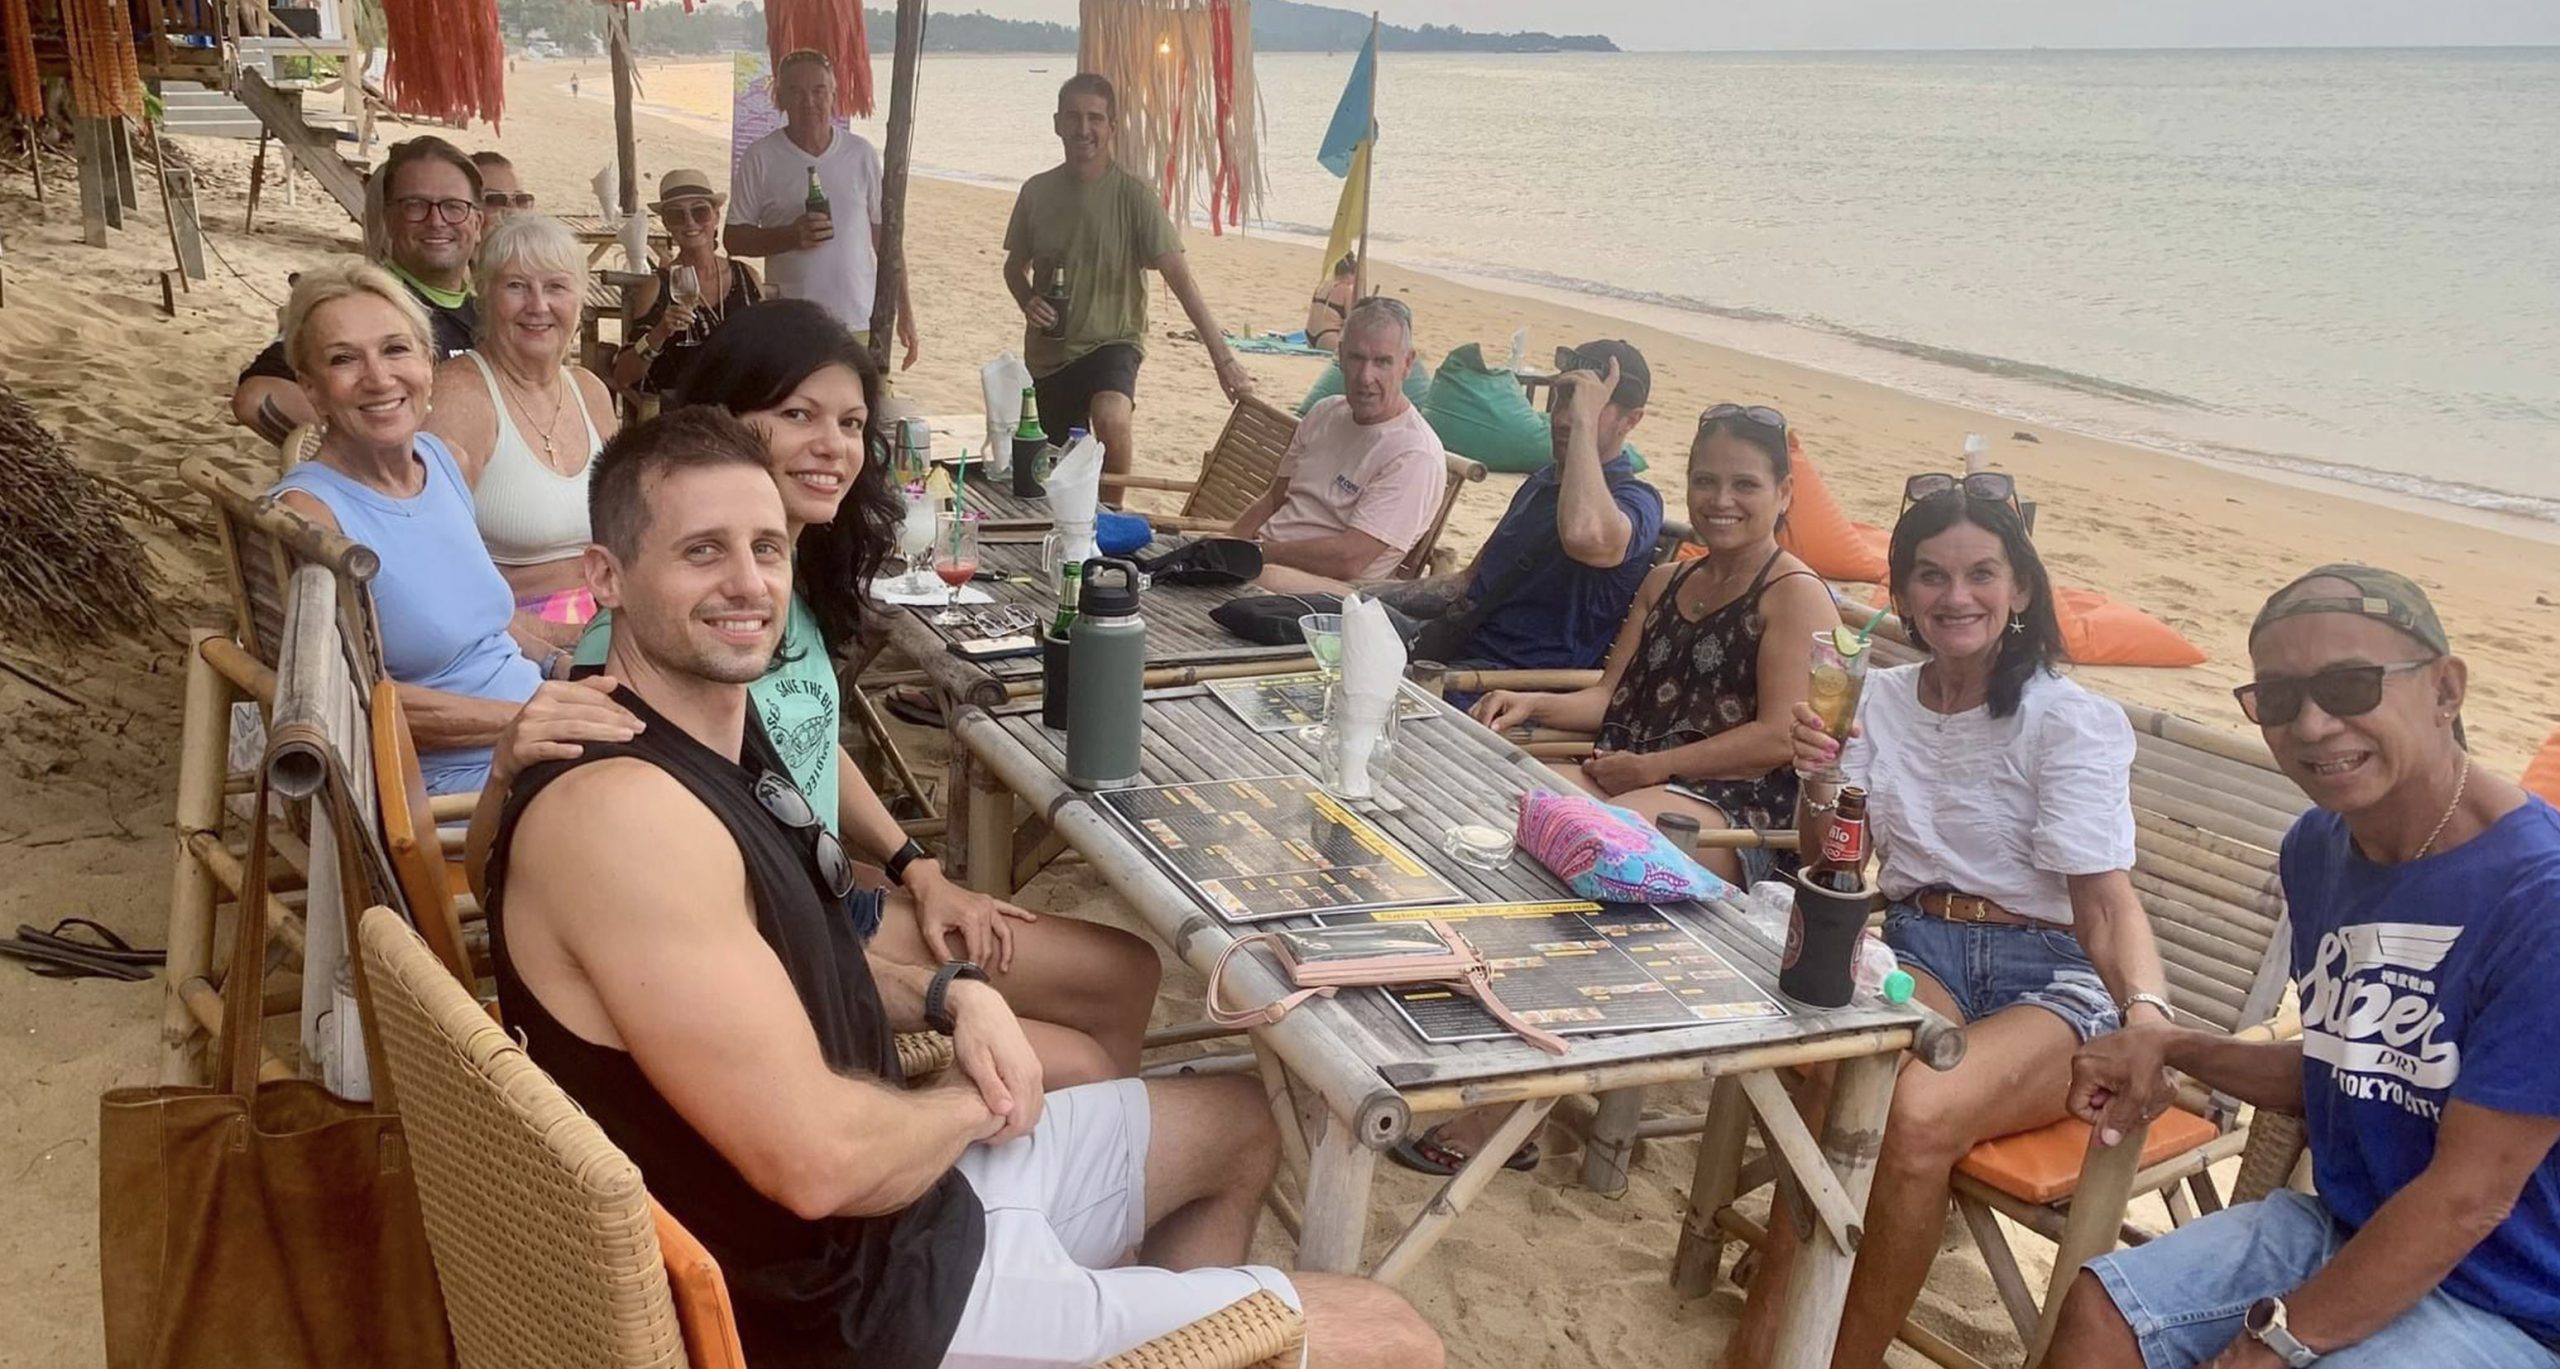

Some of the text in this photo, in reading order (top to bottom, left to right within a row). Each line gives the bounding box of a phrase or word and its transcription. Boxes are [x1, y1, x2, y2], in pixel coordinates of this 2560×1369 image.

[775, 679, 801, 698] SAVE
[802, 680, 823, 701] THE
[2299, 932, 2460, 1062] Super
[2376, 1051, 2418, 1076] DRY
[2339, 1071, 2441, 1123] TOKYO CITY
